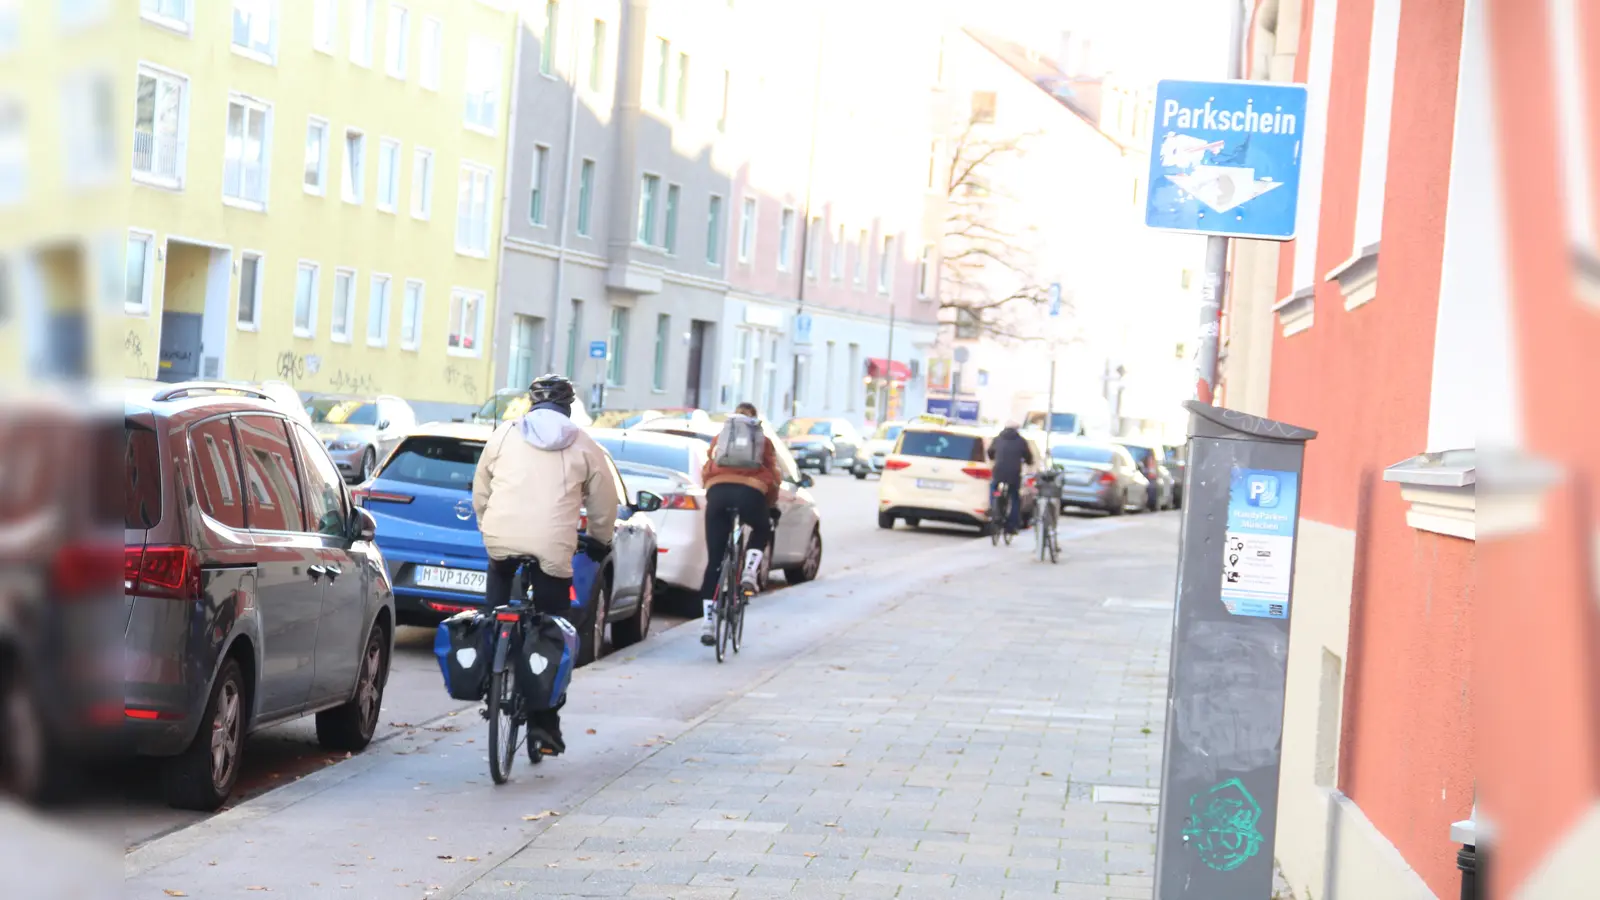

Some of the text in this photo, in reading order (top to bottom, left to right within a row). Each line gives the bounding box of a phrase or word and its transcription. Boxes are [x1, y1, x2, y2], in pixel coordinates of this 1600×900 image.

[1162, 99, 1296, 135] Parkschein
[423, 568, 485, 587] M VP 1679
